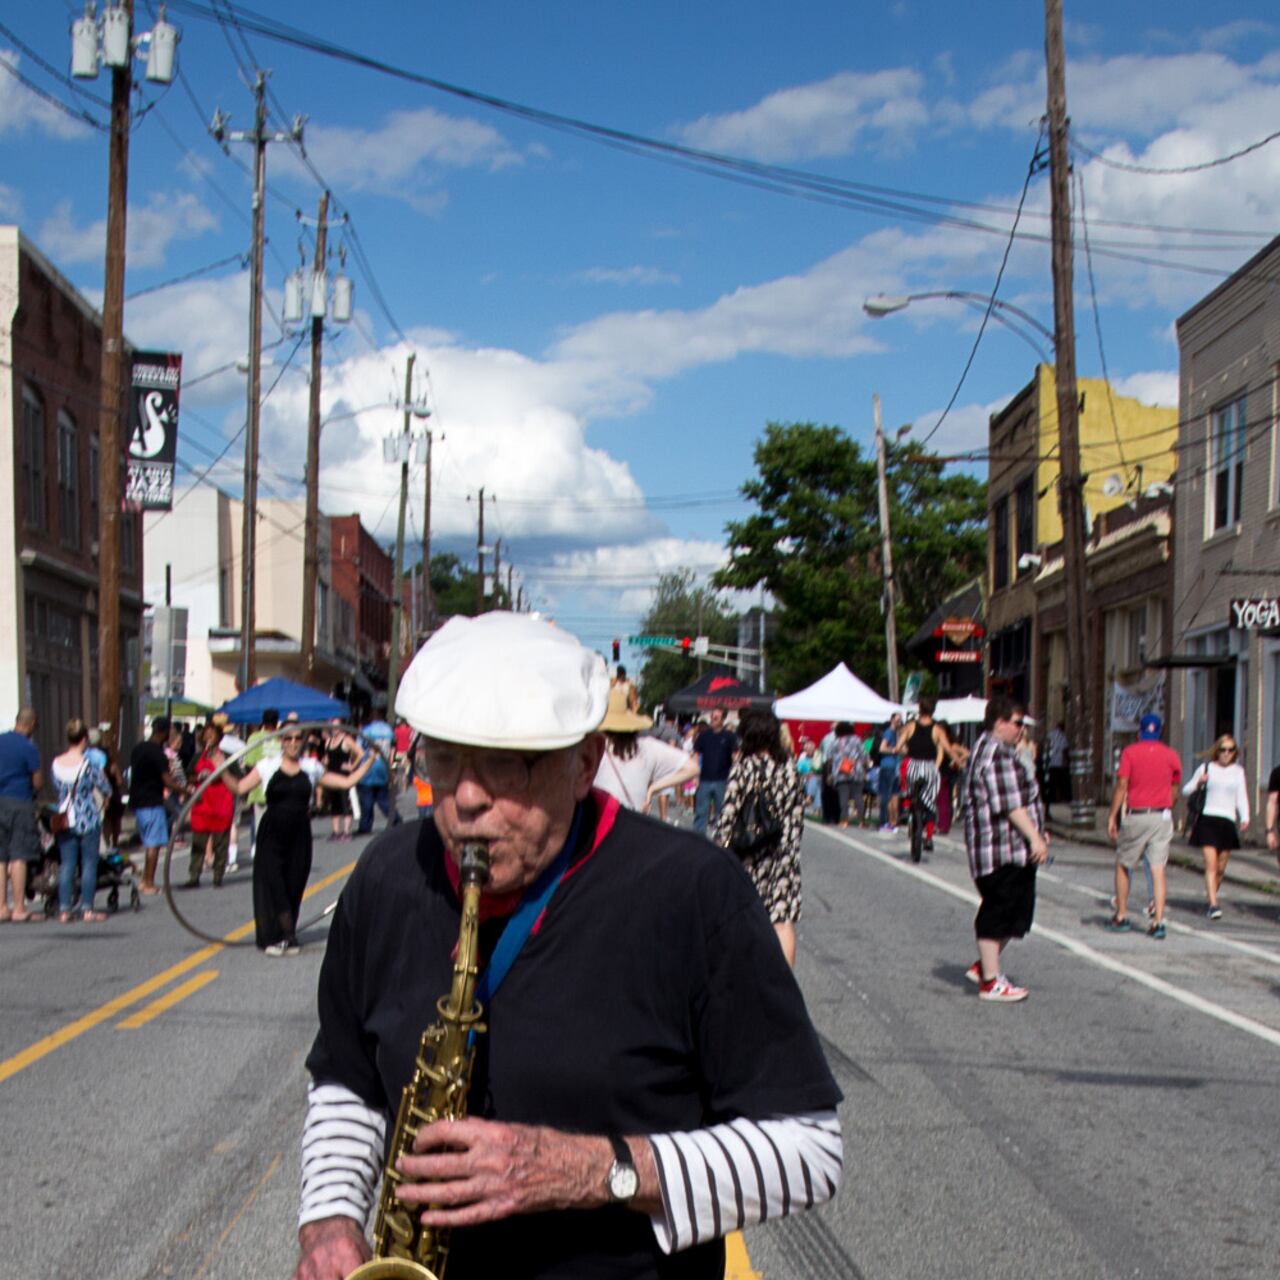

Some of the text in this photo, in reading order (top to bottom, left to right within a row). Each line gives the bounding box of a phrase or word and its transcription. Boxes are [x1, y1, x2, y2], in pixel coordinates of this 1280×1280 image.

[128, 466, 171, 478] ATLANTA
[127, 474, 171, 494] JAZZ
[126, 489, 171, 503] FESTIVAL
[1232, 599, 1280, 628] YOGA
[940, 651, 977, 662] MOTHER
